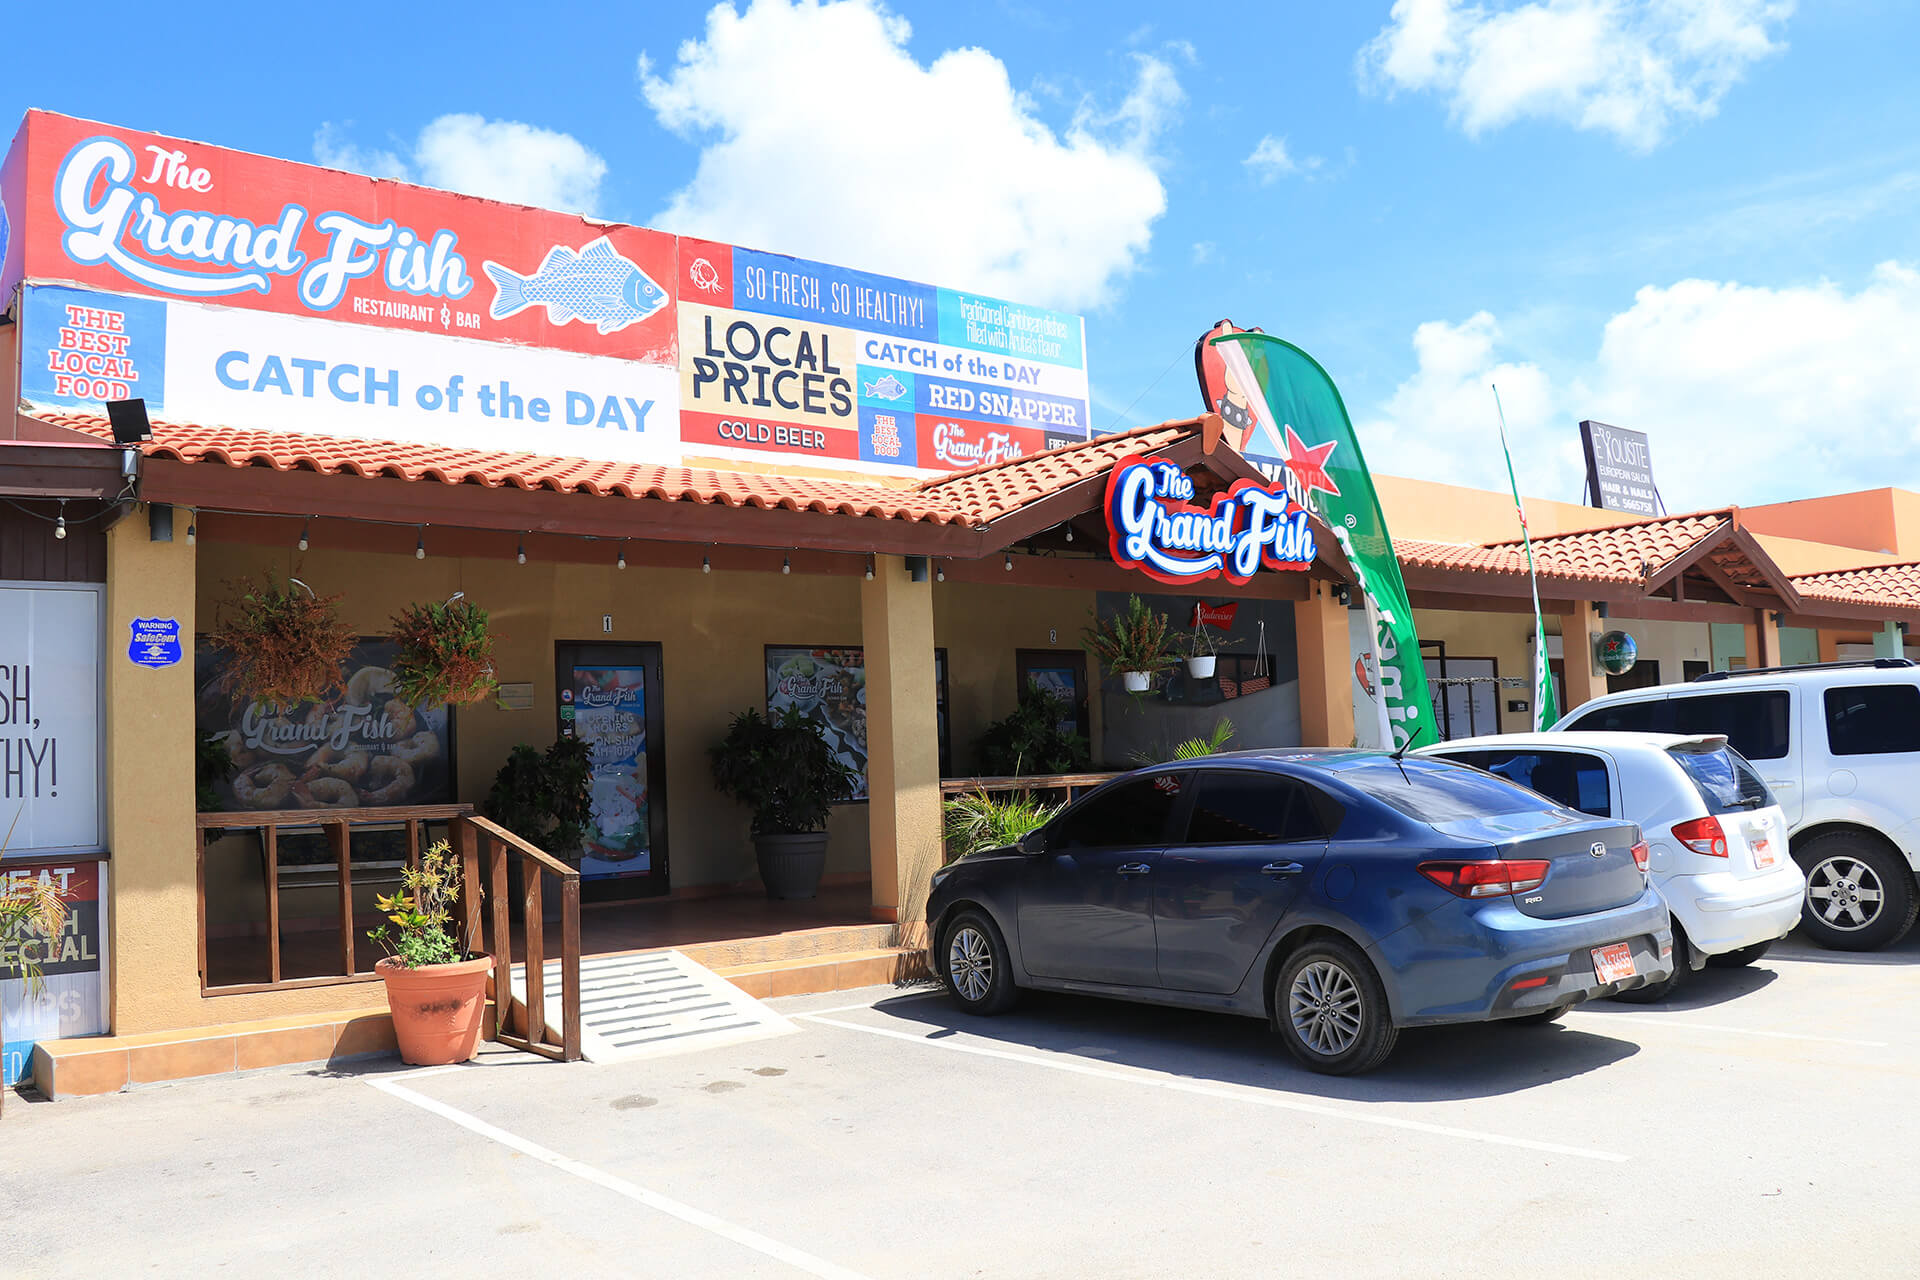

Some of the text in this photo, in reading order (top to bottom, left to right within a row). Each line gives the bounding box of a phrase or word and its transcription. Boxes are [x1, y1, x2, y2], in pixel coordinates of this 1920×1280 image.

[142, 145, 214, 193] The
[57, 138, 472, 309] Grand Fish
[745, 265, 924, 329] SO FRESH, SO HEALTHY!
[958, 295, 1003, 326] Traditional
[66, 304, 125, 332] THE
[353, 296, 434, 323] RESTAURANT
[456, 311, 481, 329] BAR
[59, 329, 130, 356] BEST
[704, 315, 841, 375] LOCAL
[966, 320, 987, 345] filled
[988, 327, 1008, 350] with
[49, 351, 138, 380] LOCAL
[865, 339, 1041, 385] CATCH of the DAY
[55, 375, 130, 401] FOOD
[215, 350, 655, 433] CATCH of the DAY
[692, 356, 852, 417] PRICES
[928, 383, 1079, 427] RED SNAPPER
[718, 420, 826, 450] COLD BEER
[874, 425, 898, 436] BEST
[875, 415, 896, 426] THE
[948, 422, 965, 437] The
[872, 434, 901, 447] LOCAL
[873, 445, 899, 457] FOOD
[933, 423, 1022, 467] Grand Fish
[1158, 464, 1193, 498] The
[1601, 481, 1621, 494] HAIR
[1630, 487, 1654, 500] NAILS
[1120, 465, 1317, 577] Grand Fish
[135, 633, 176, 642] SafeCom
[138, 622, 172, 630] WARNING
[242, 701, 397, 755] Grand Fish
[0, 738, 58, 798] HY!
[1524, 896, 1543, 904] RIO
